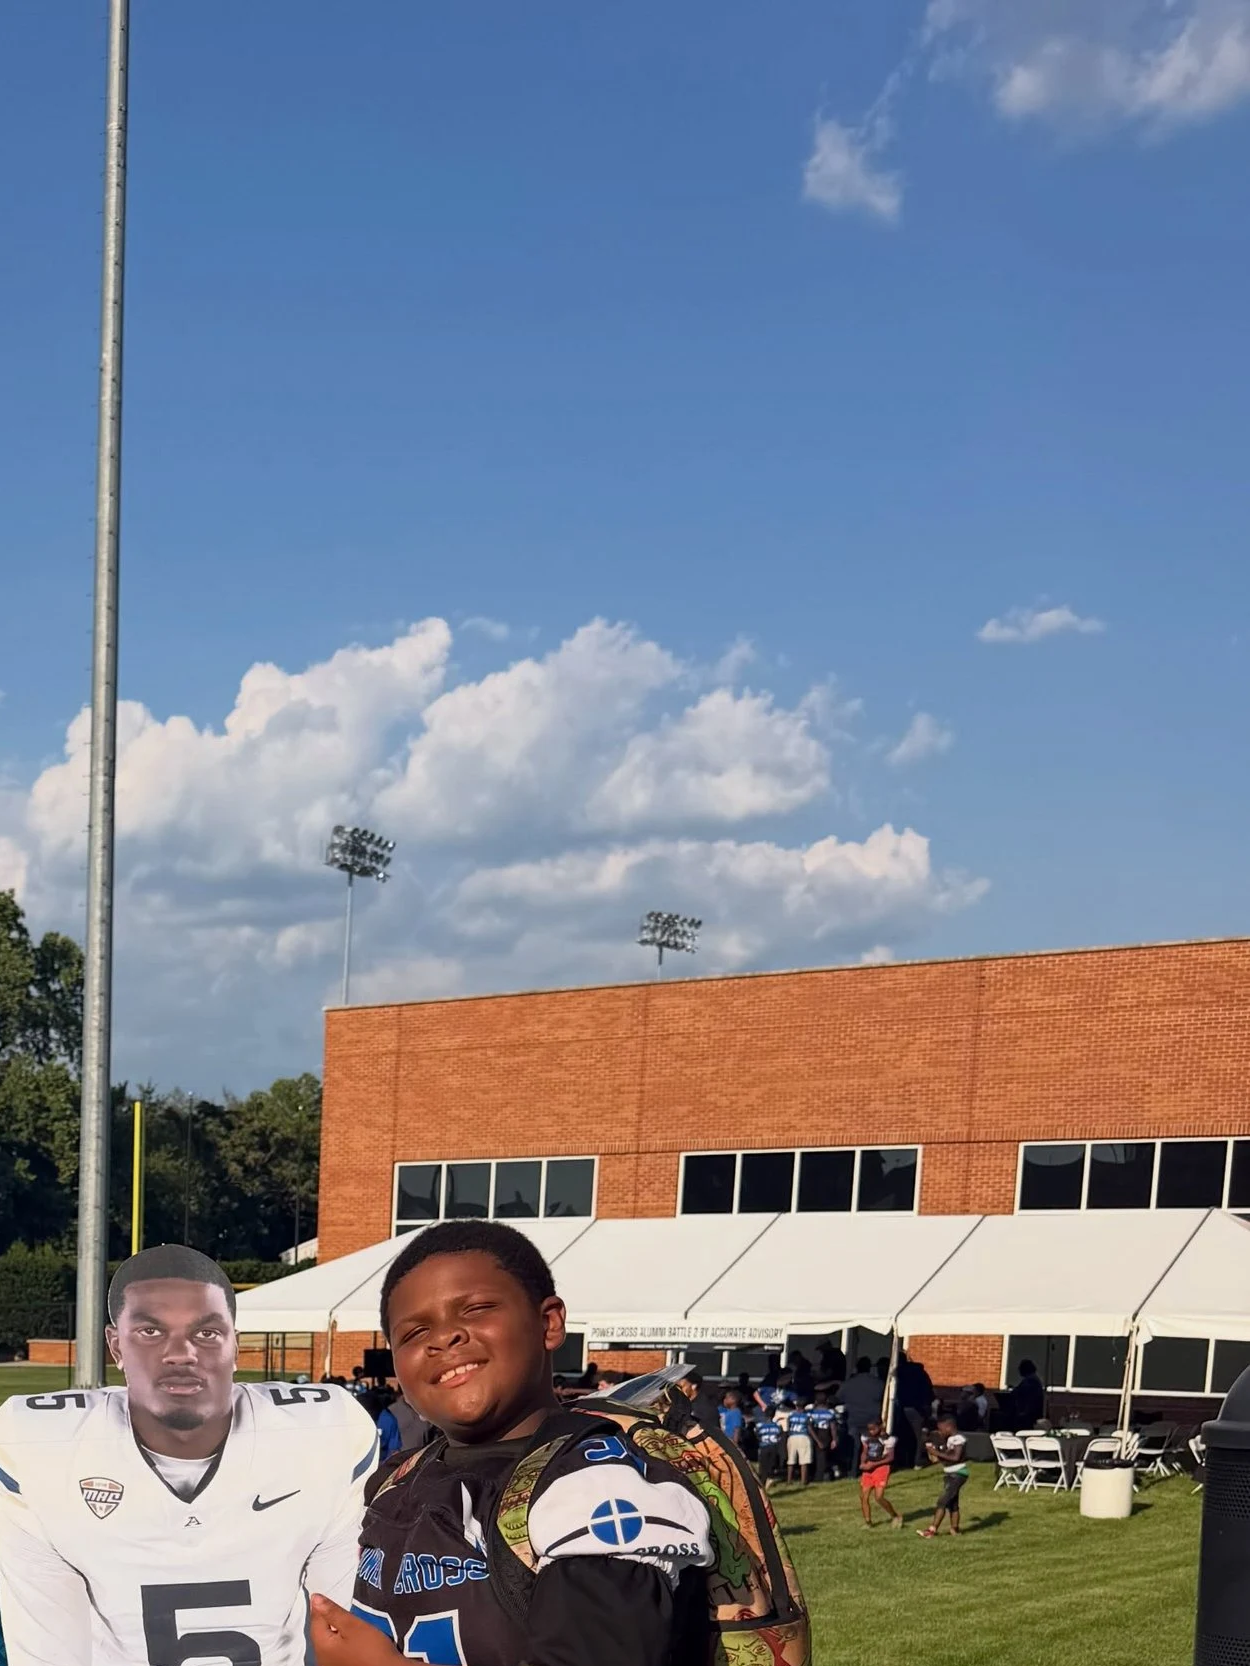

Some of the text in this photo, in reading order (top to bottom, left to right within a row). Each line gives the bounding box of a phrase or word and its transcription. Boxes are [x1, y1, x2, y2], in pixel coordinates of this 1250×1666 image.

[591, 1327, 784, 1340] POWER CROSS ALUMNI BATTLE 2 BY ACCURATE ADVISORY
[26, 1393, 86, 1411] 5
[269, 1387, 330, 1406] 5
[83, 1489, 123, 1503] MAC
[184, 1516, 202, 1527] A
